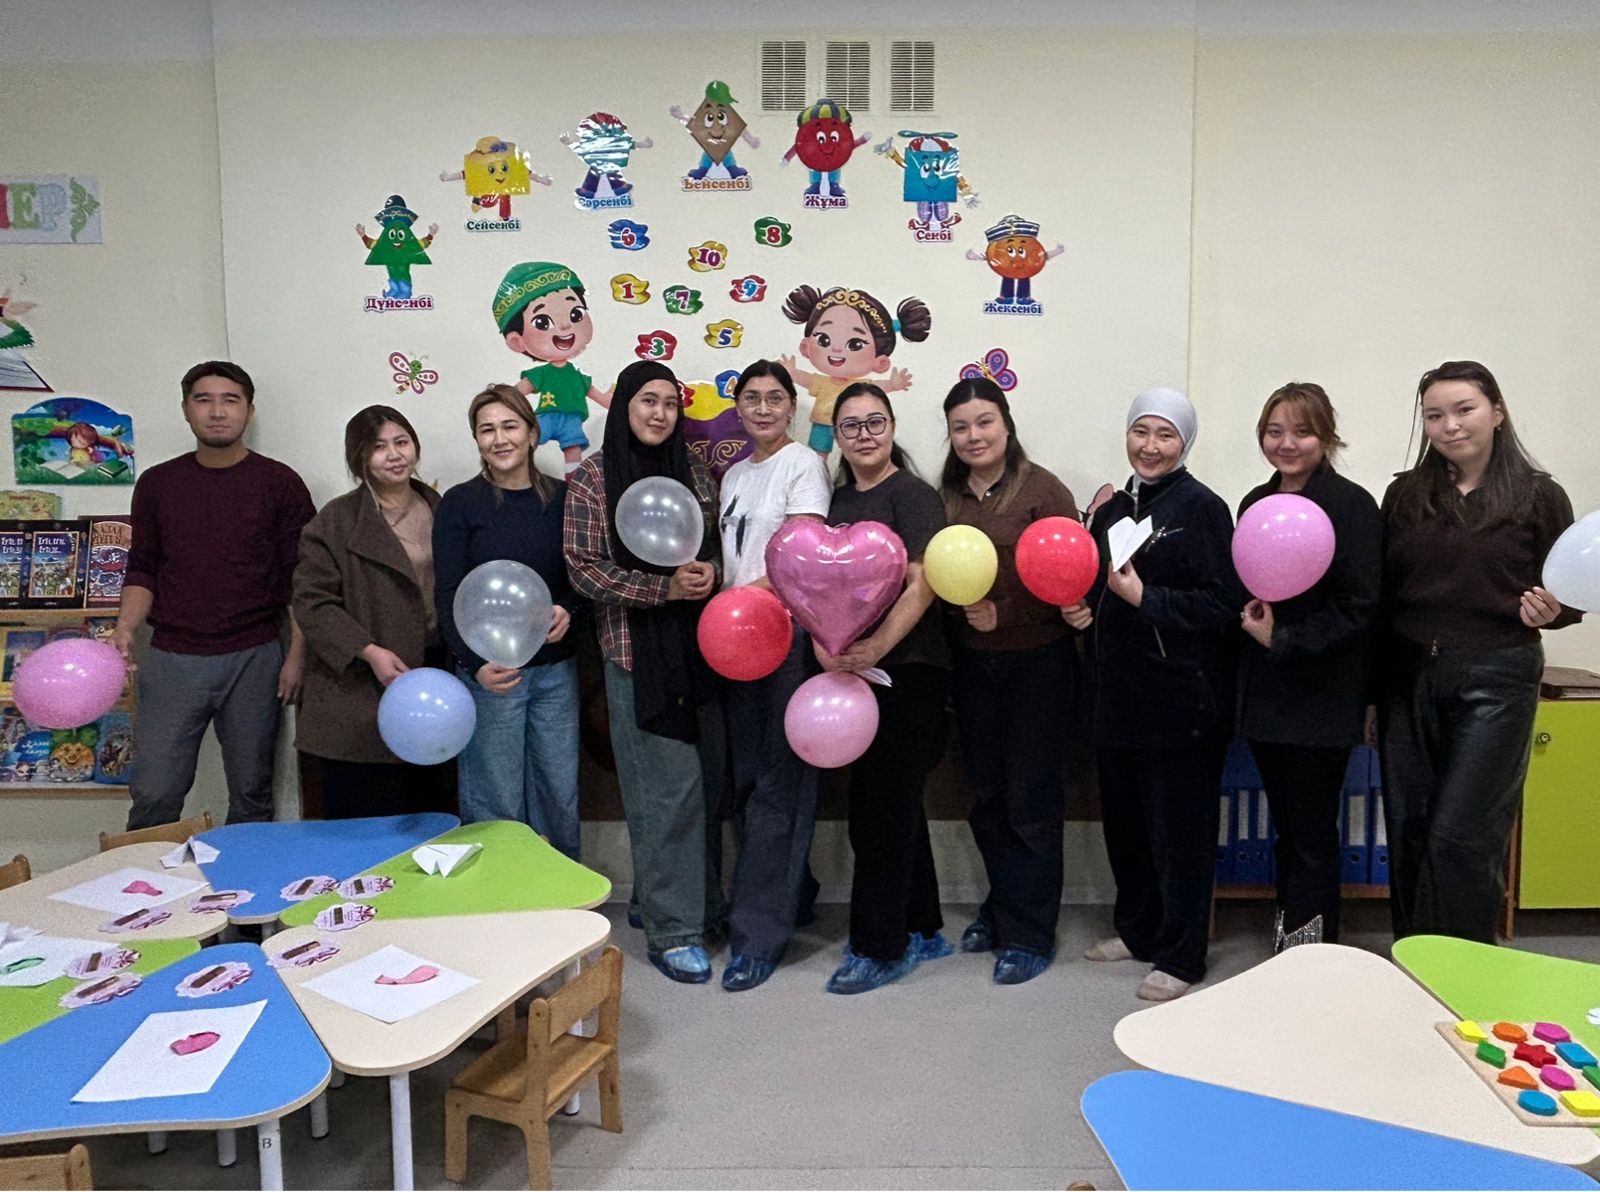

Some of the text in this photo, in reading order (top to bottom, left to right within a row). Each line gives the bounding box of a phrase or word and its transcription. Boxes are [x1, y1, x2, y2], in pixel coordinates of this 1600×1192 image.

[622, 228, 636, 246] 6
[767, 226, 780, 243] 8
[916, 229, 952, 241] Сенбі
[697, 248, 721, 267] 10
[622, 283, 635, 299] 1
[743, 280, 757, 297] 9
[676, 290, 689, 310] 7
[984, 302, 1042, 313] Жексенбі
[718, 329, 733, 346] 5
[650, 338, 665, 357] 3
